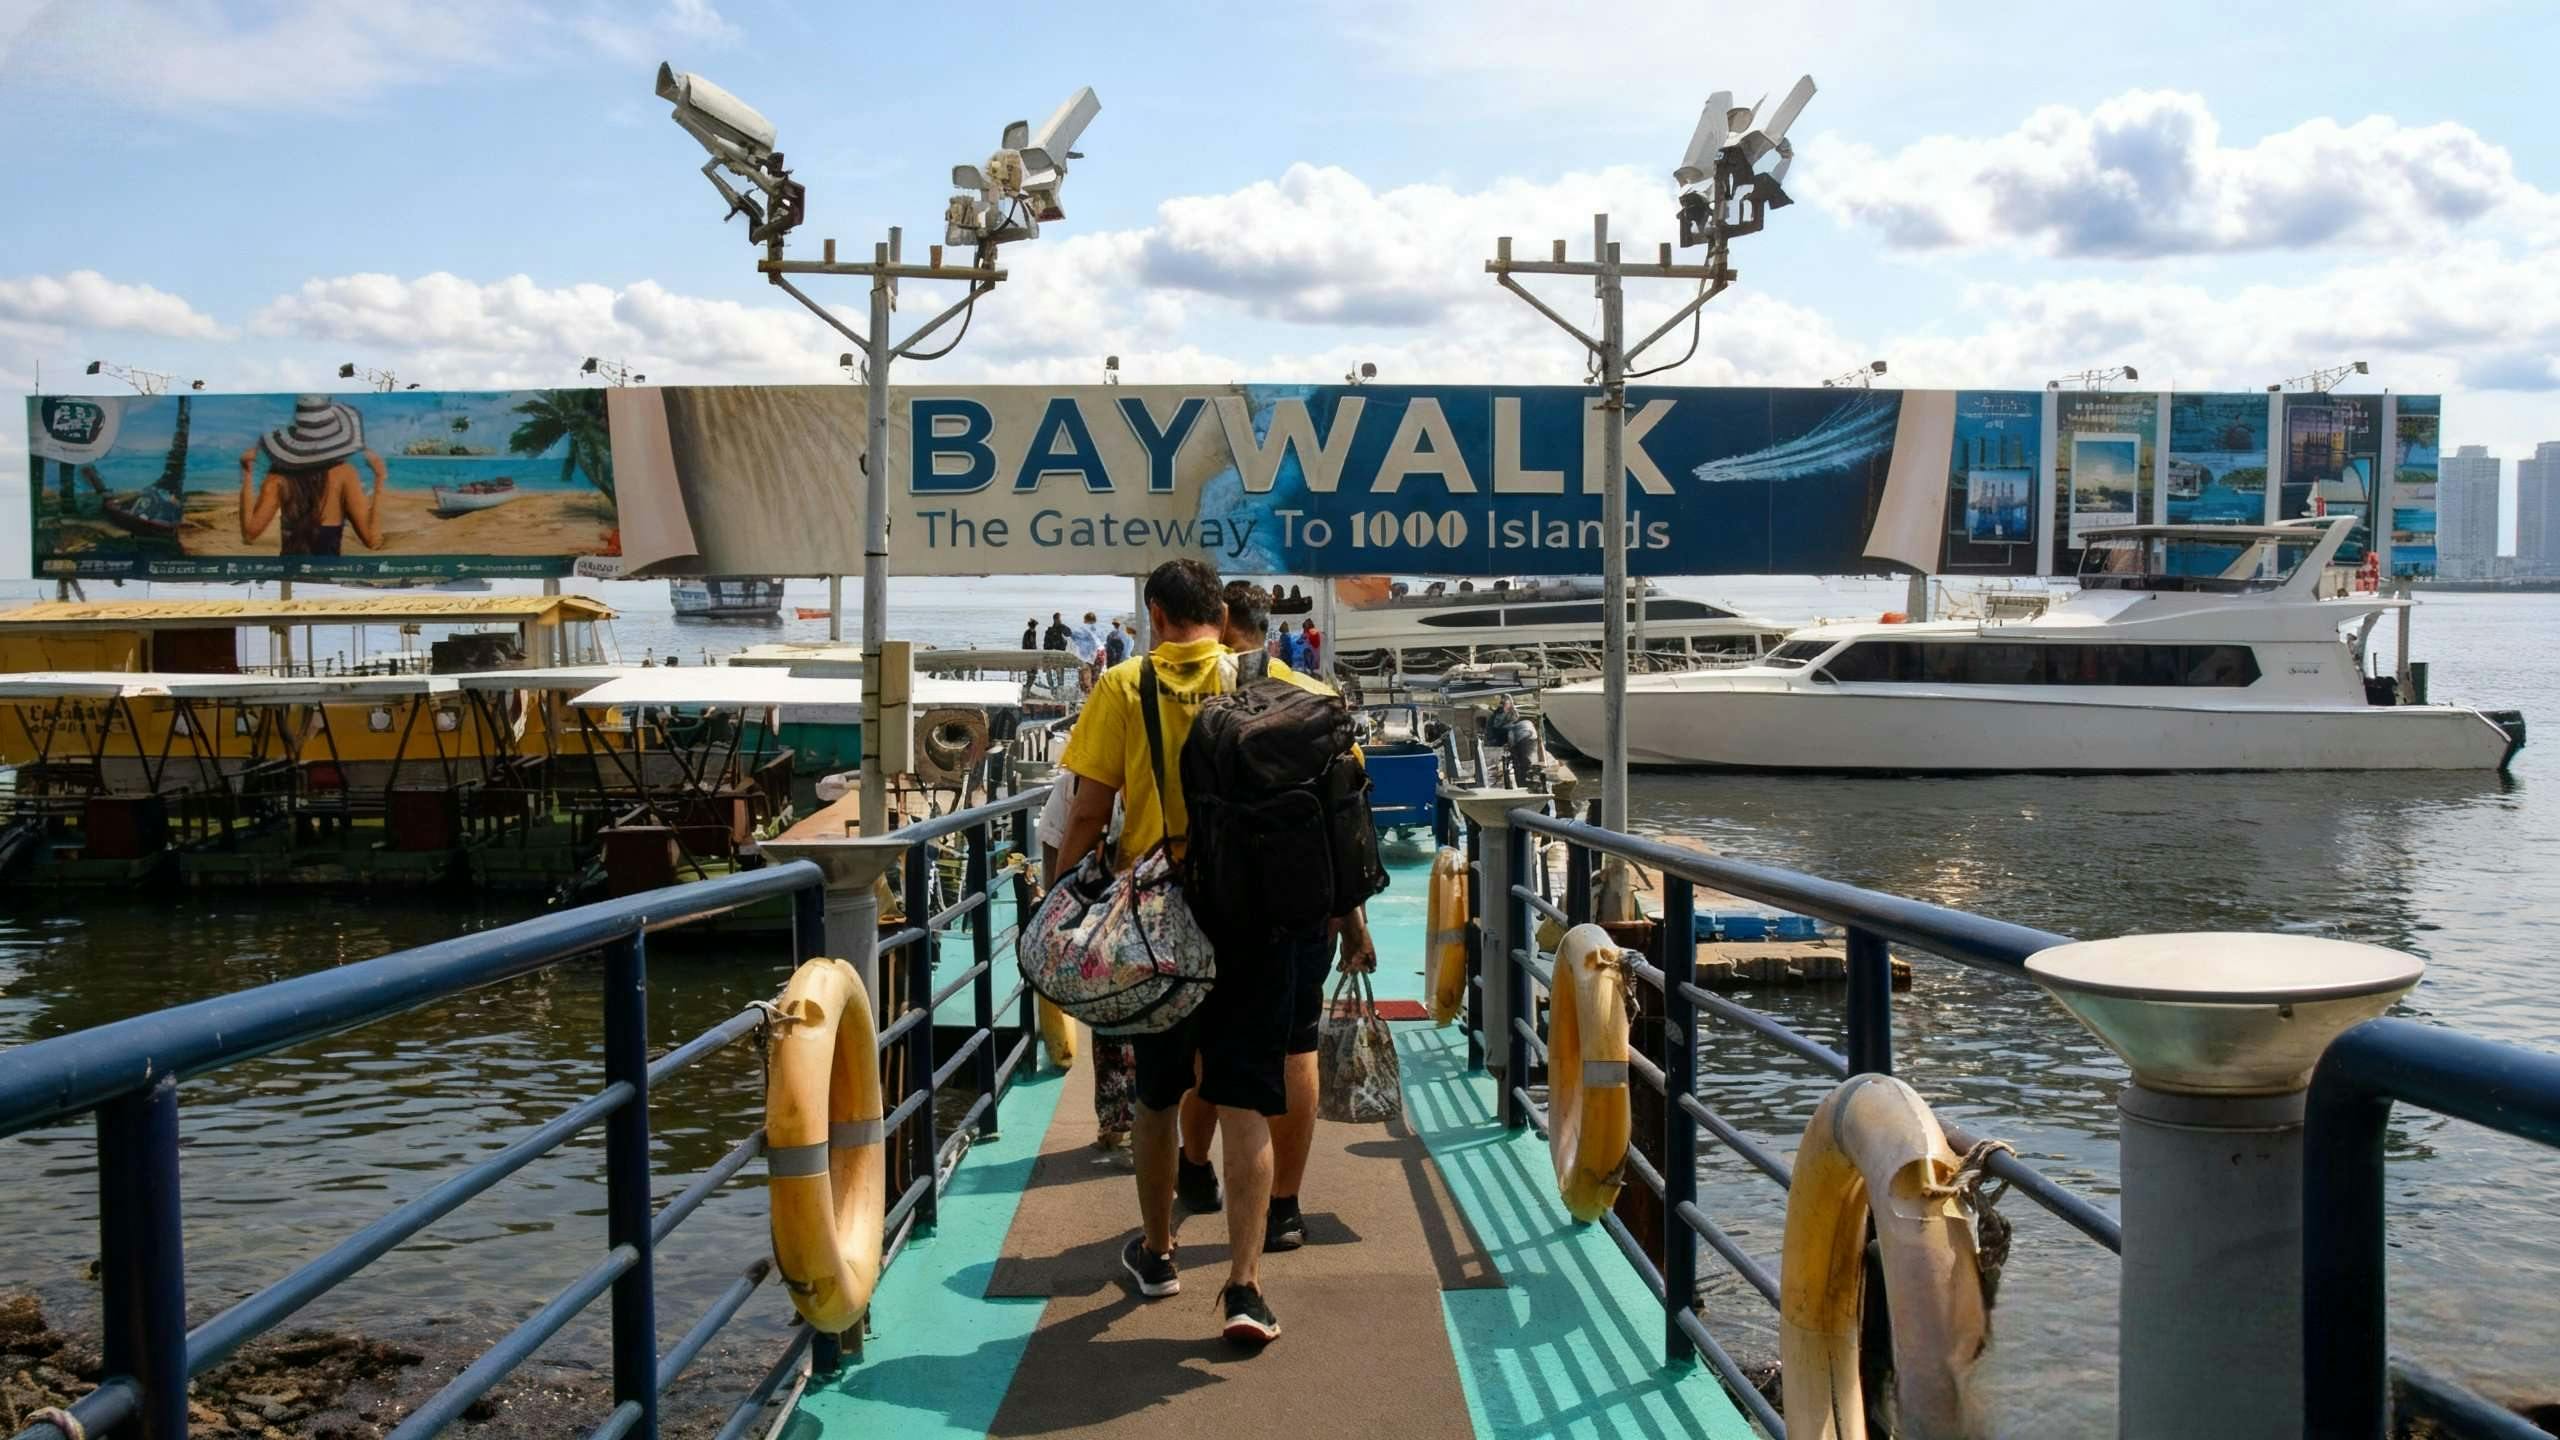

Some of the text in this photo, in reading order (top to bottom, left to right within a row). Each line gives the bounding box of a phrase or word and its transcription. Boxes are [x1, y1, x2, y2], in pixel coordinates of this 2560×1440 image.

[909, 396, 1679, 496] BAYWALK
[916, 508, 1671, 558] The Gateway To 1000 Islands
